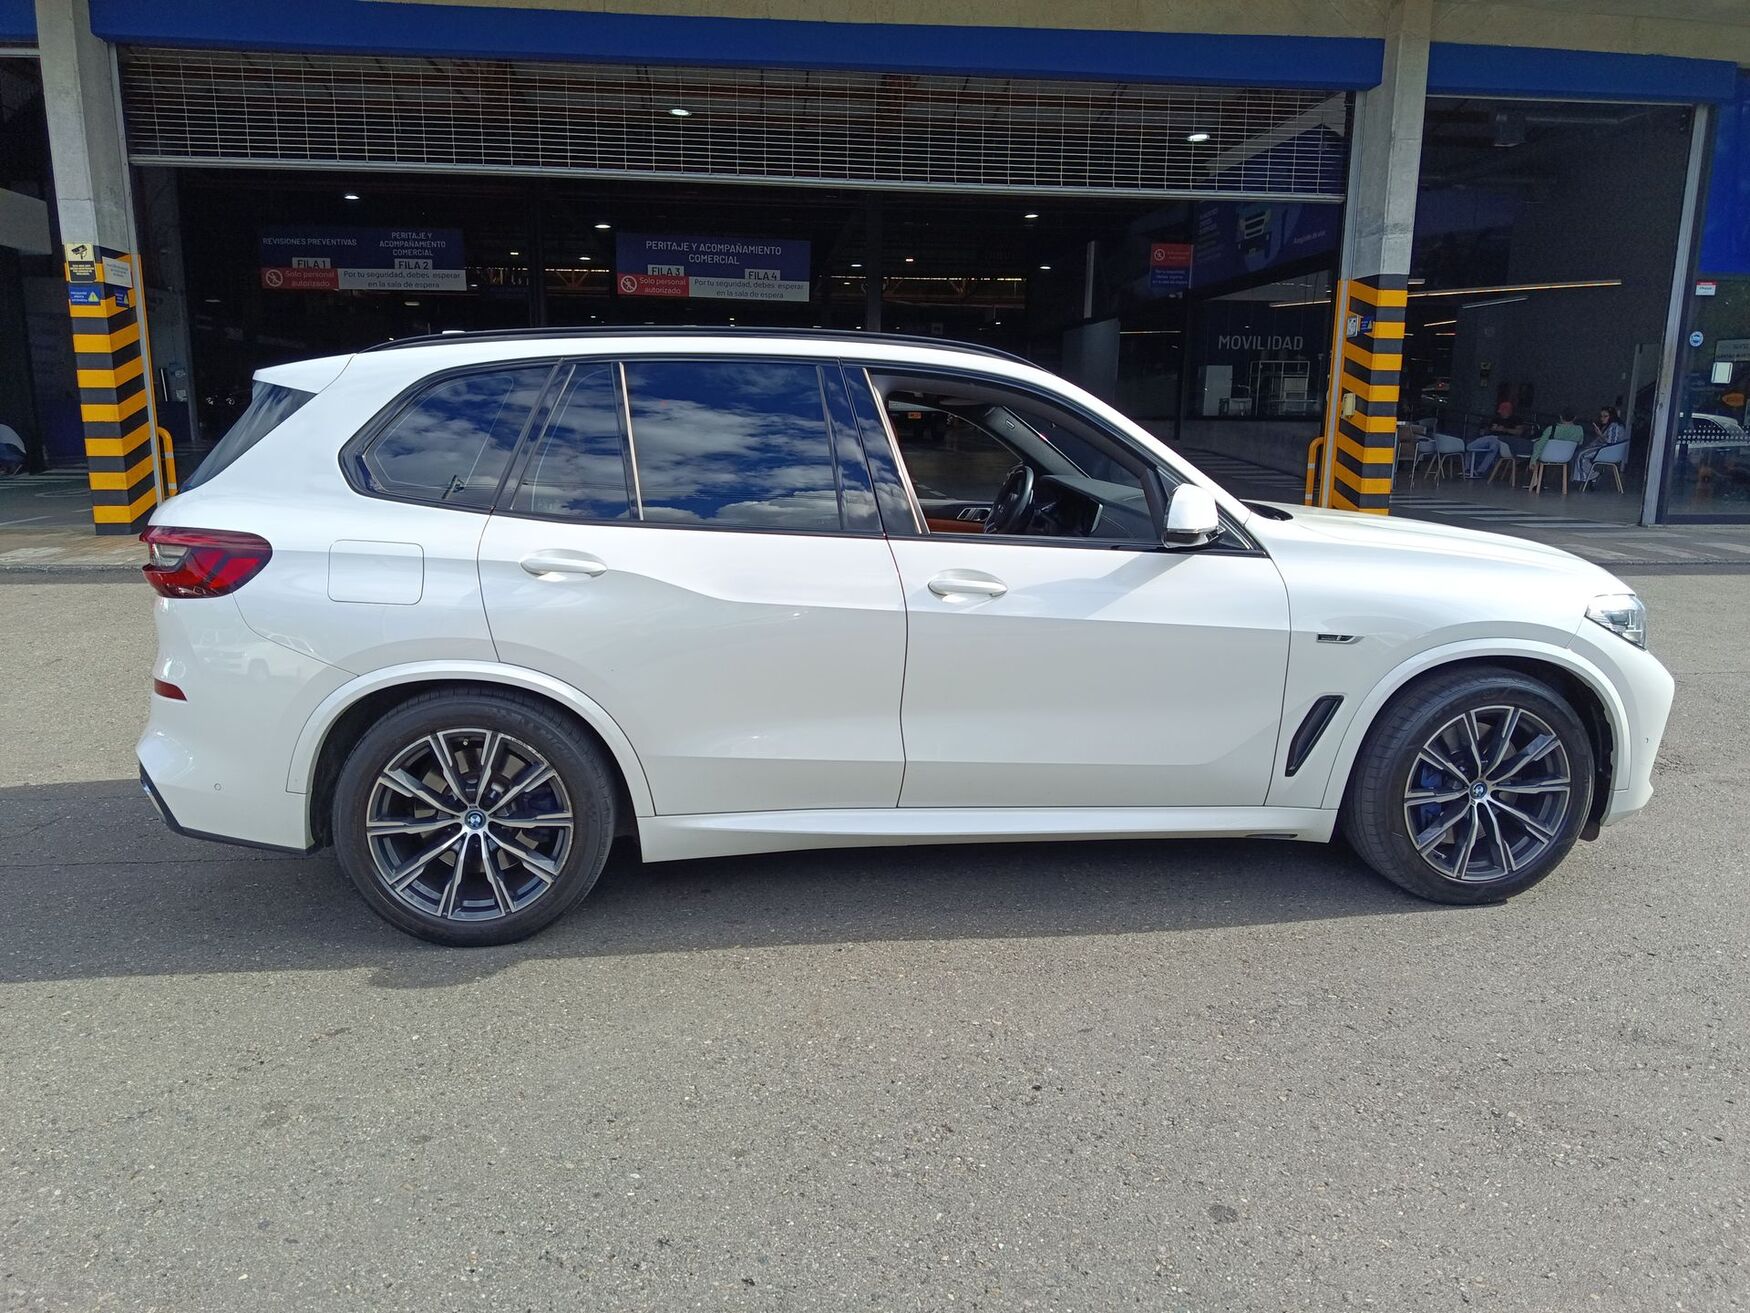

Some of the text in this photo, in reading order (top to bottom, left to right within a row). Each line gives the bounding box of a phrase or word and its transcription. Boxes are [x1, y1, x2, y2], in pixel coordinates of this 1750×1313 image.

[262, 238, 358, 246] REVISIONES PREVENTIVAS
[646, 240, 782, 255] PERITAJE Y ACOMPAÑAMIENTO
[297, 260, 320, 268] FILA
[689, 254, 740, 265] COMERCIAL
[398, 260, 429, 269] FILA 2
[344, 270, 356, 278] Por
[652, 267, 681, 276] FILA 3
[748, 271, 777, 281] FILA 4
[656, 278, 686, 286] personal
[1218, 335, 1303, 350] MOVILIDAD
